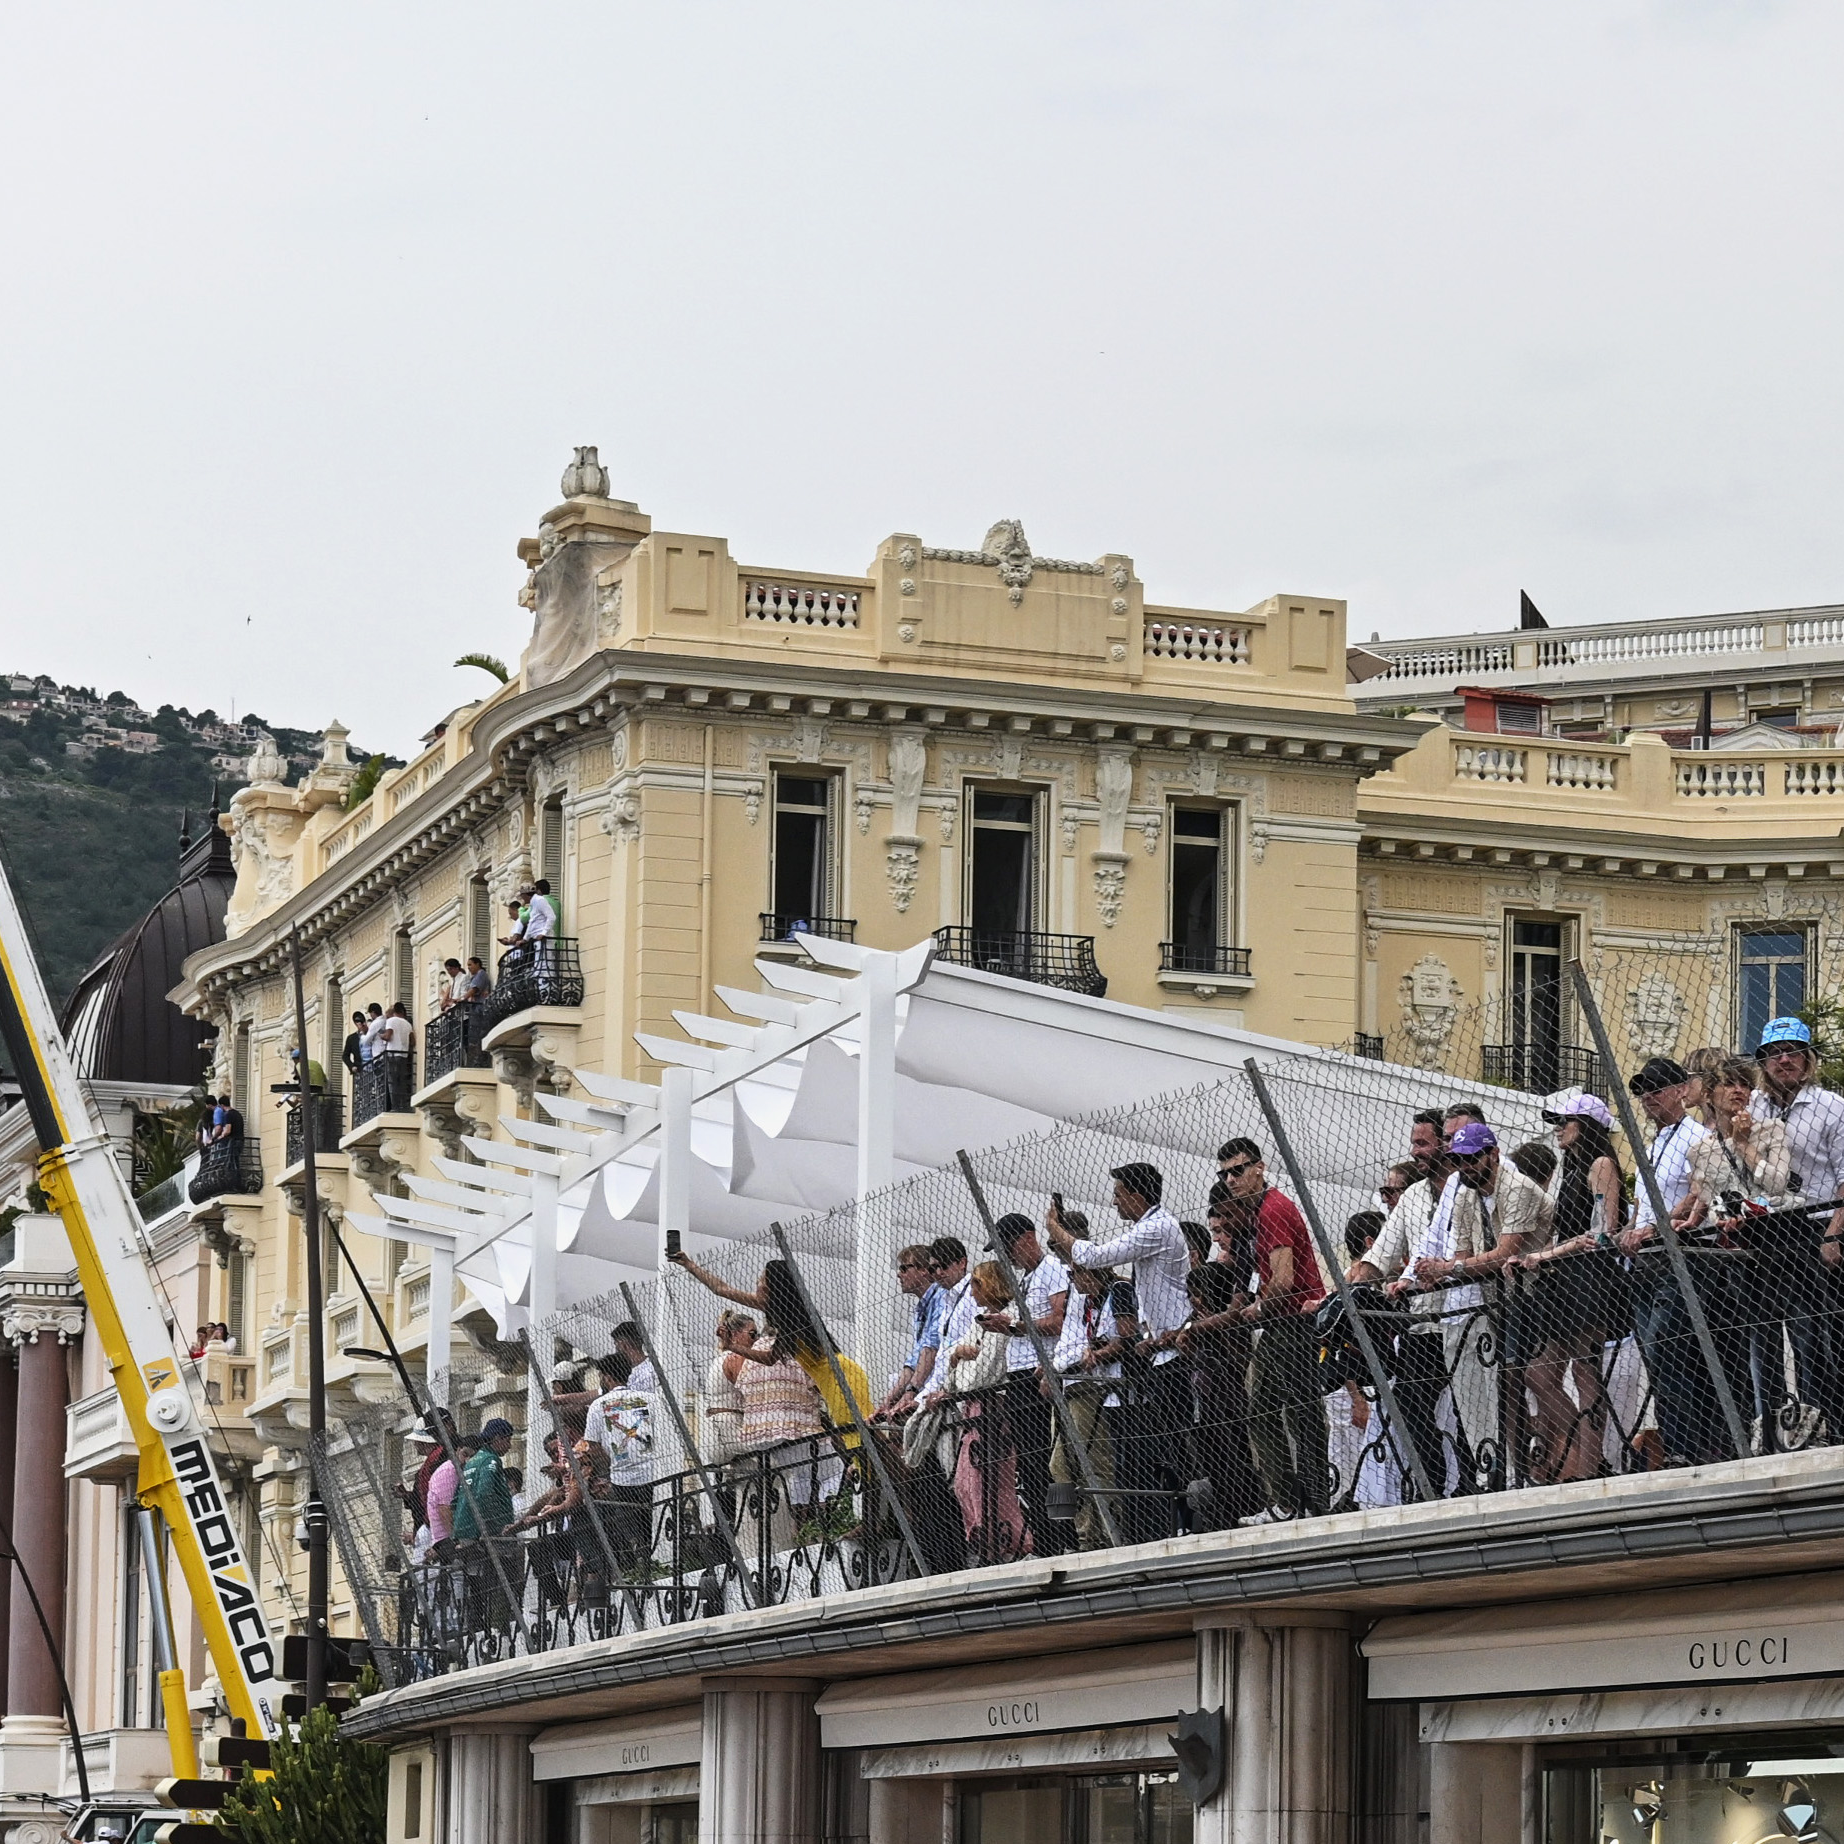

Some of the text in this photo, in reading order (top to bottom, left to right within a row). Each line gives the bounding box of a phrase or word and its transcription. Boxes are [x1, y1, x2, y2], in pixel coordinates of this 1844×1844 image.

[1688, 1636, 1789, 1670] GUCCI
[987, 1702, 1041, 1728] GUCCI
[621, 1745, 651, 1765] GUCCI
